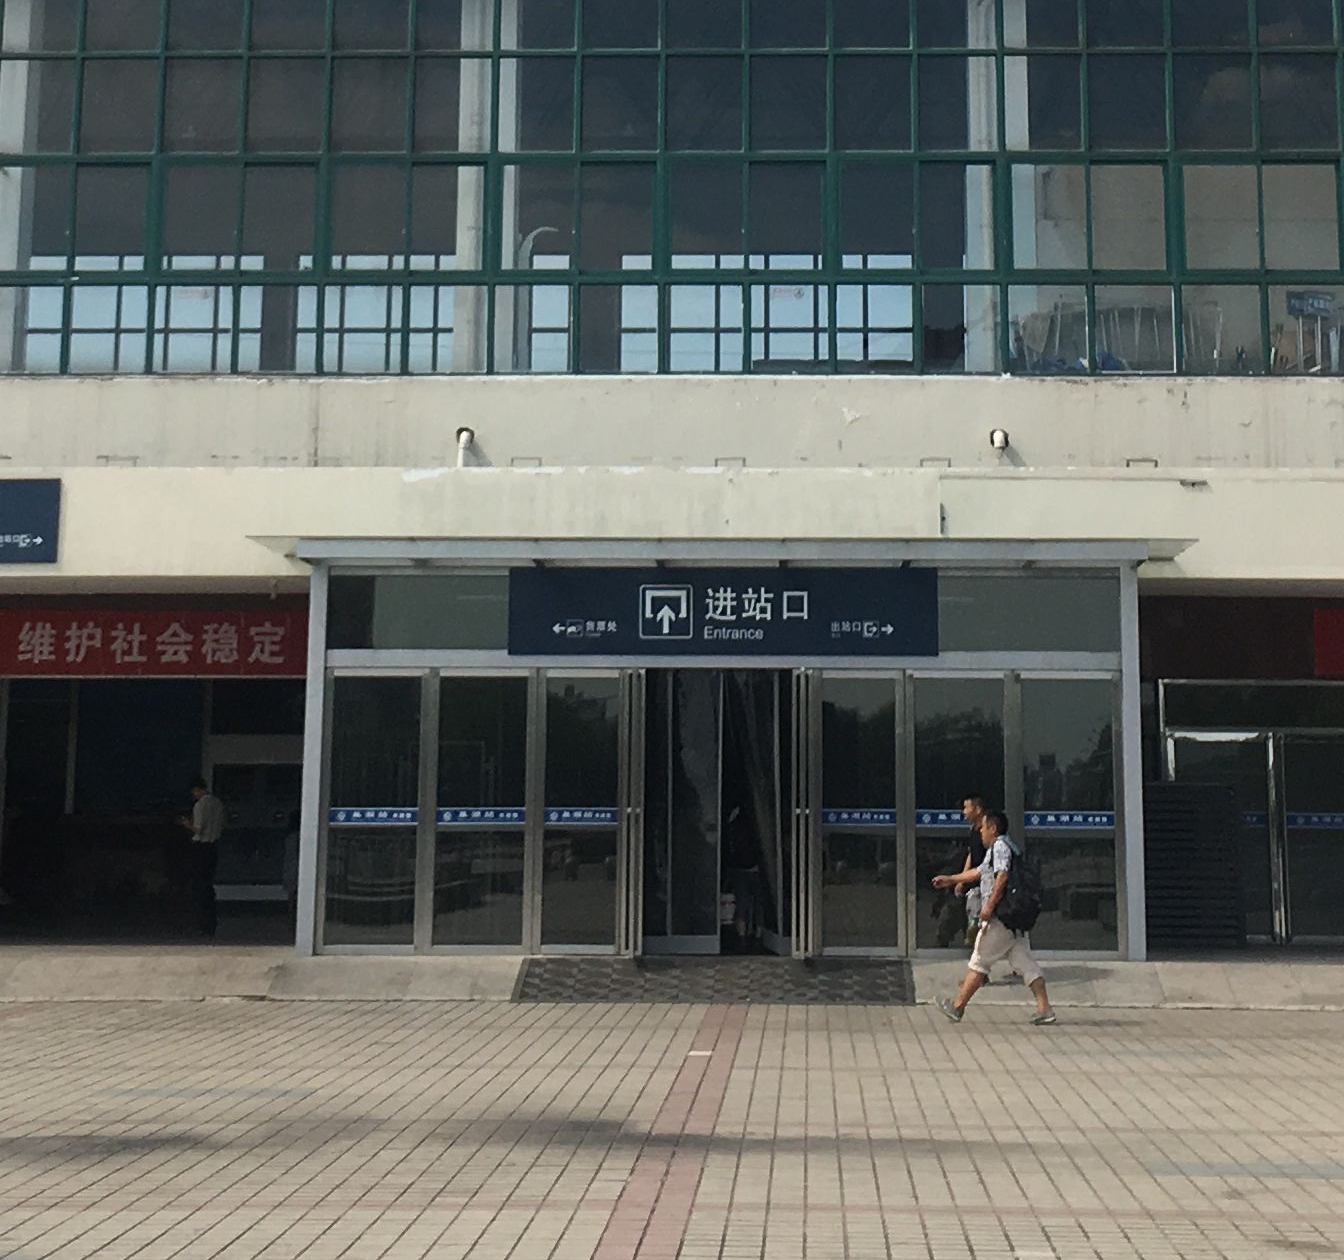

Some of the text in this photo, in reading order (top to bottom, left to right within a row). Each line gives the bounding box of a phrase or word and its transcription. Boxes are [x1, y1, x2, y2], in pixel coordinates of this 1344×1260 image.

[704, 587, 809, 621] 进站口
[17, 620, 287, 665] 维护社会稳定
[703, 626, 764, 640] Entrance
